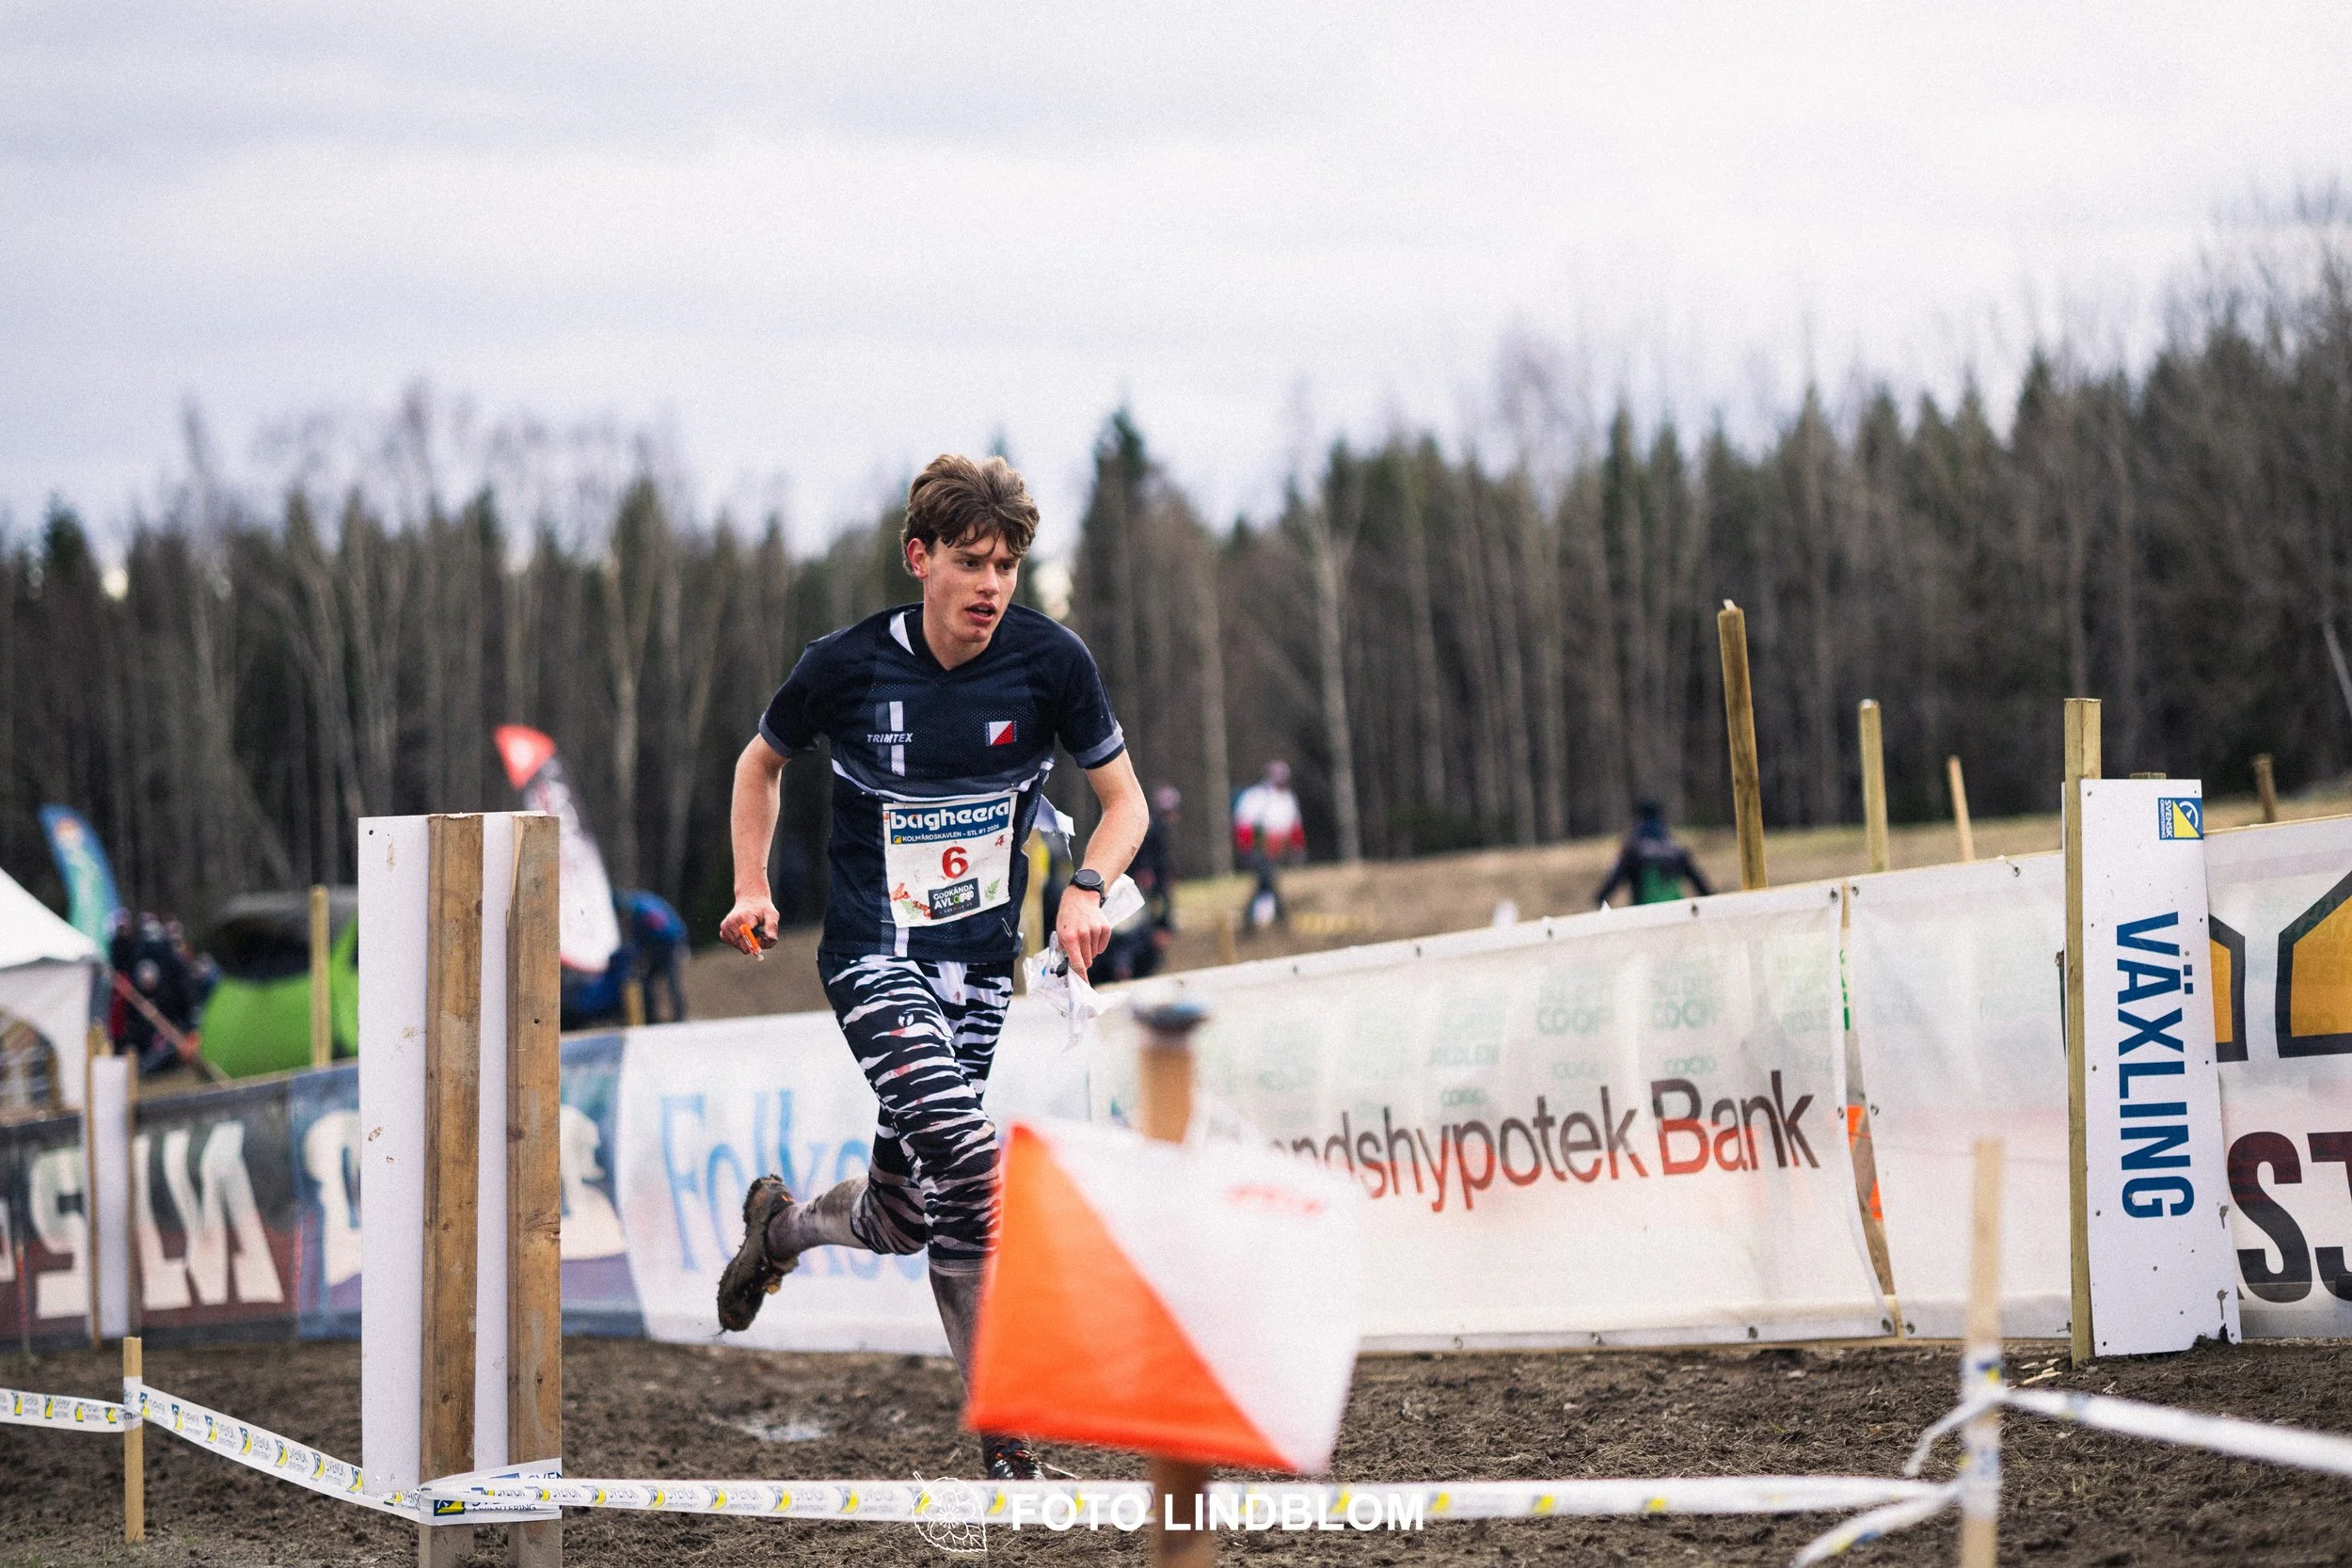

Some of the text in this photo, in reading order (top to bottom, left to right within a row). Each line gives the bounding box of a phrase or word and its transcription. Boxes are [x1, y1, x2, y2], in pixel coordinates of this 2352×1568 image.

[867, 733, 914, 743] TRIMTEX
[890, 801, 1009, 831] bagheera
[2165, 800, 2173, 838] SVENSK
[902, 831, 961, 842] KOLMÅRDSKAVLEN
[942, 847, 969, 879] 6
[933, 883, 974, 900] GODKÄNDA
[2117, 911, 2195, 1218] VÄXLING
[1272, 1070, 1820, 1212] dshypotek Bank
